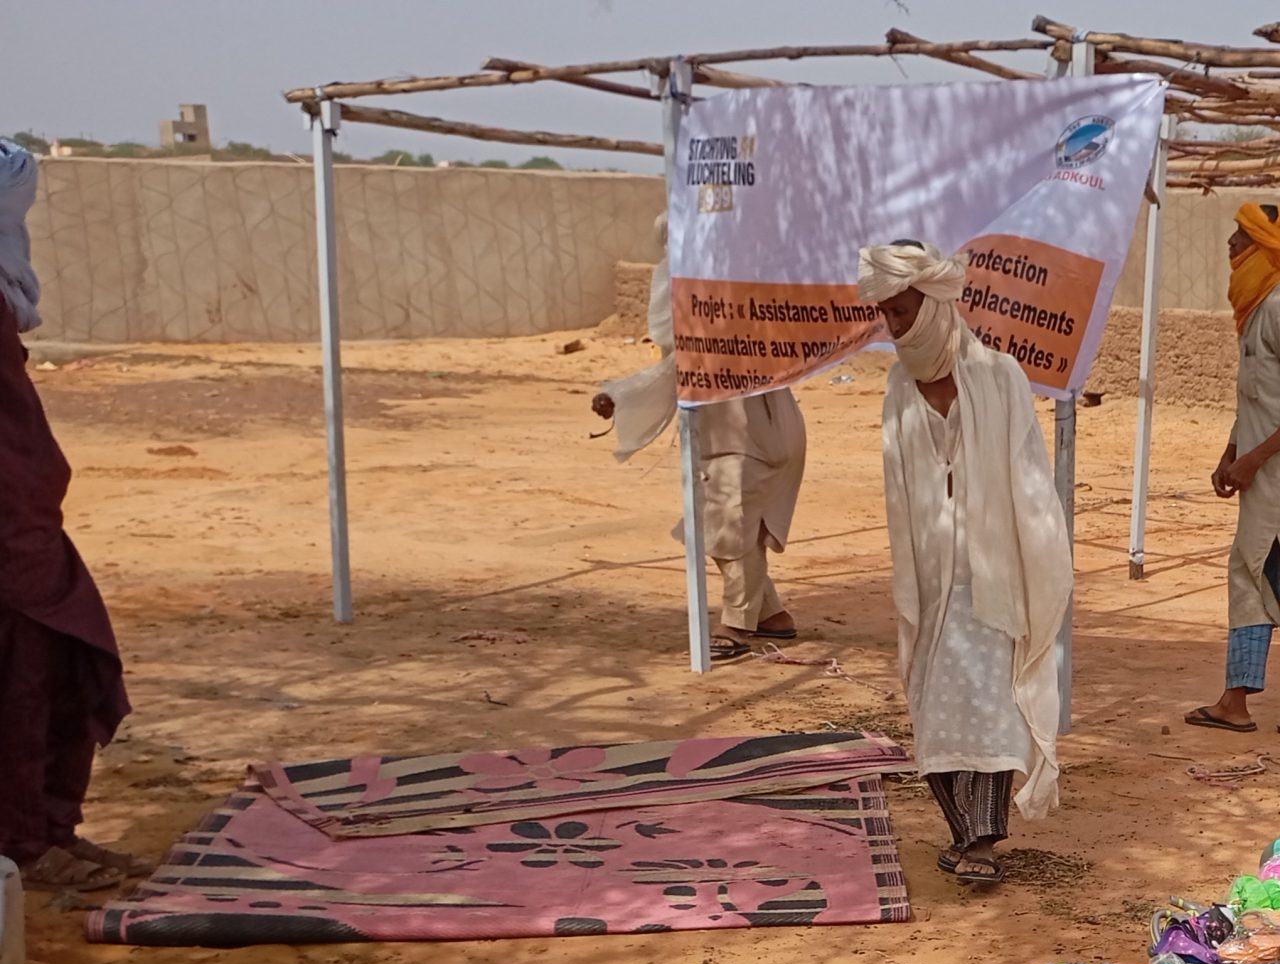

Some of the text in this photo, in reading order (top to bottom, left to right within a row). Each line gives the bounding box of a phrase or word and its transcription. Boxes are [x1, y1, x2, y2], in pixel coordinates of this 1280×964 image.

[691, 294, 727, 324] Projet
[750, 297, 828, 323] Assistance
[955, 280, 1075, 337] éplacements
[675, 333, 767, 358] communautaire
[770, 340, 799, 358] aux
[1006, 334, 1055, 371] hôtes
